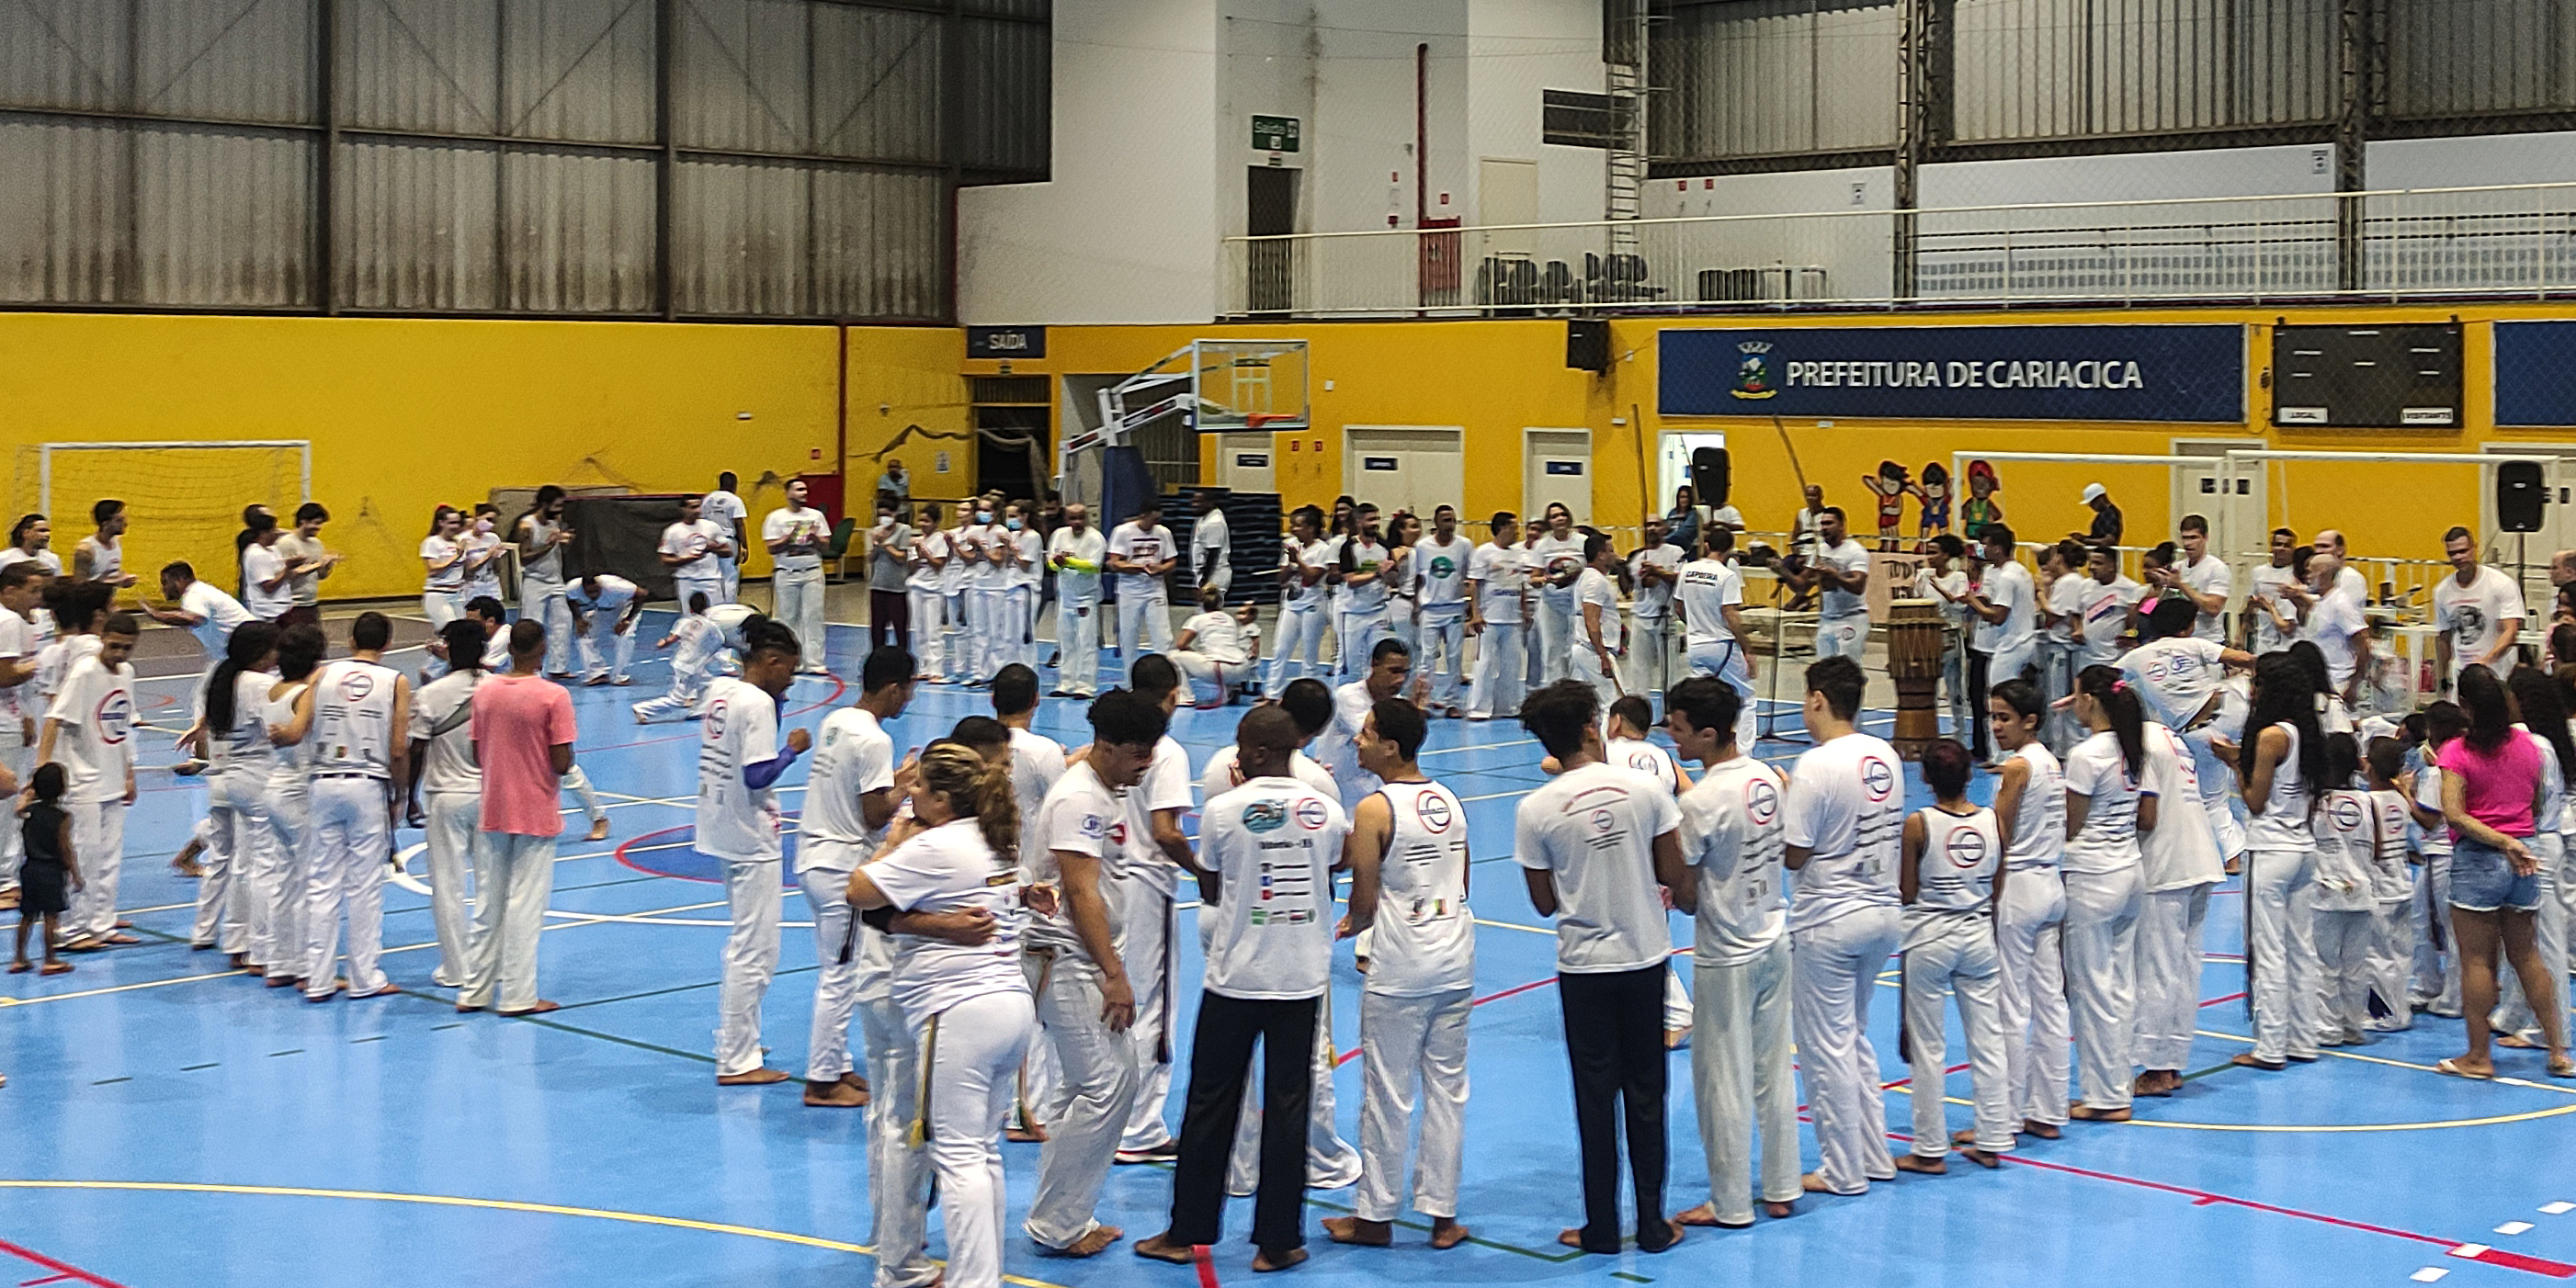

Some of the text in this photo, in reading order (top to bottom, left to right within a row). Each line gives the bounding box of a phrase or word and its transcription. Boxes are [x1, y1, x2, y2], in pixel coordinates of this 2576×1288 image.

[989, 329, 1027, 349] SAÍDA
[1787, 360, 2142, 389] PREFEITURA DE CARIACICA
